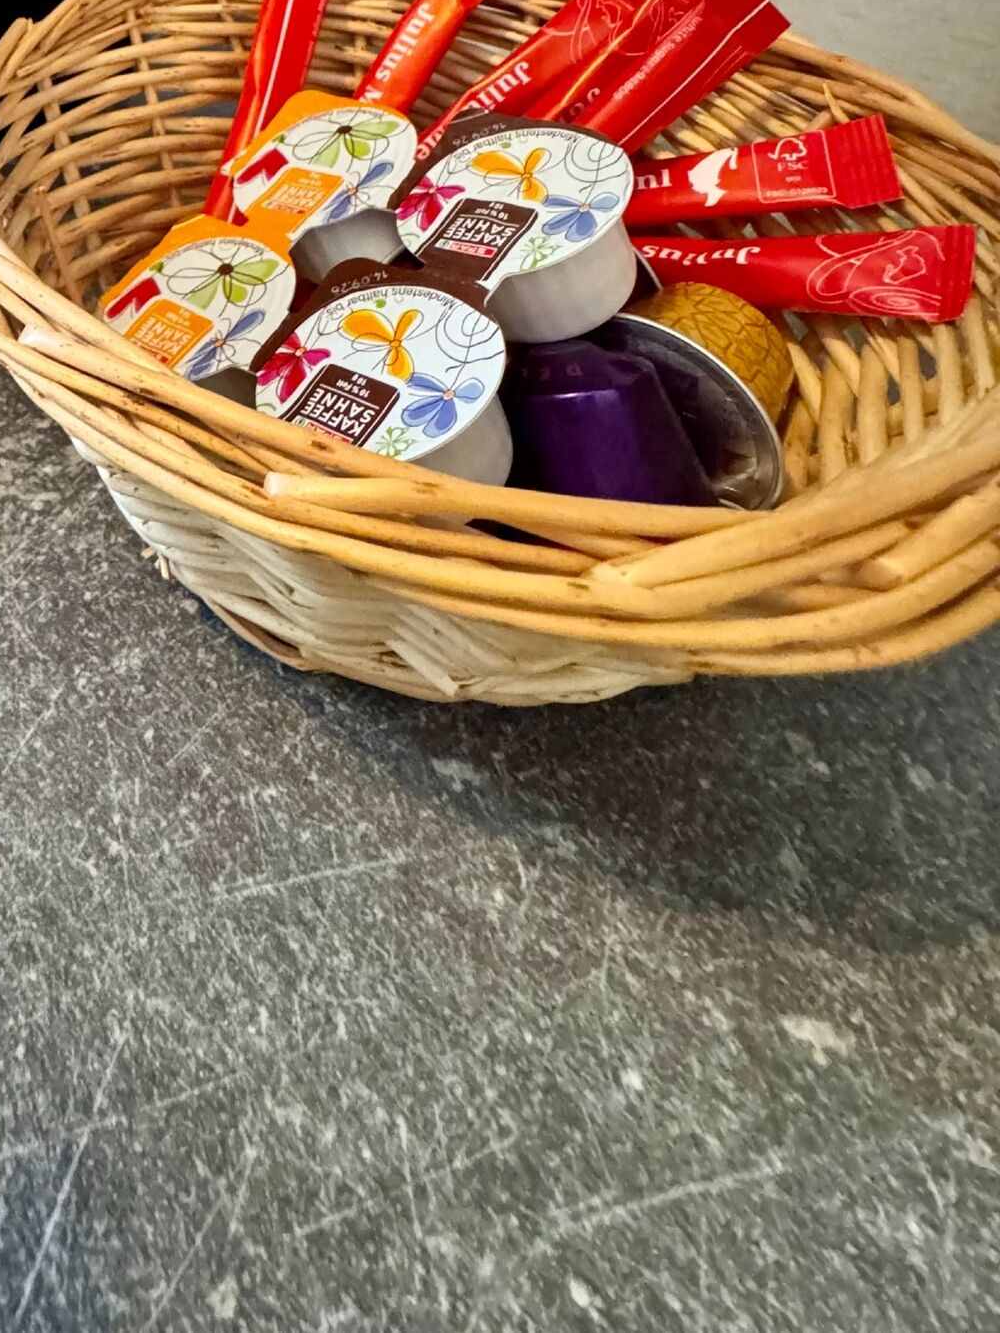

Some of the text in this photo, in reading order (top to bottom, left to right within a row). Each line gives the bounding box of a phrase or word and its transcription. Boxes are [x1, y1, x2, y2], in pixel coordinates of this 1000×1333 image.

[375, 2, 434, 82] Julius
[473, 132, 513, 152] haltbar
[442, 226, 508, 247] KAFFEE
[453, 217, 517, 237] SAHNE
[641, 245, 761, 265] Julius
[346, 288, 389, 307] haltbar
[391, 286, 460, 310] Mindestens
[143, 317, 193, 345] SAHNE
[308, 388, 376, 424] SAHNE
[300, 398, 366, 437] KAFFEE
